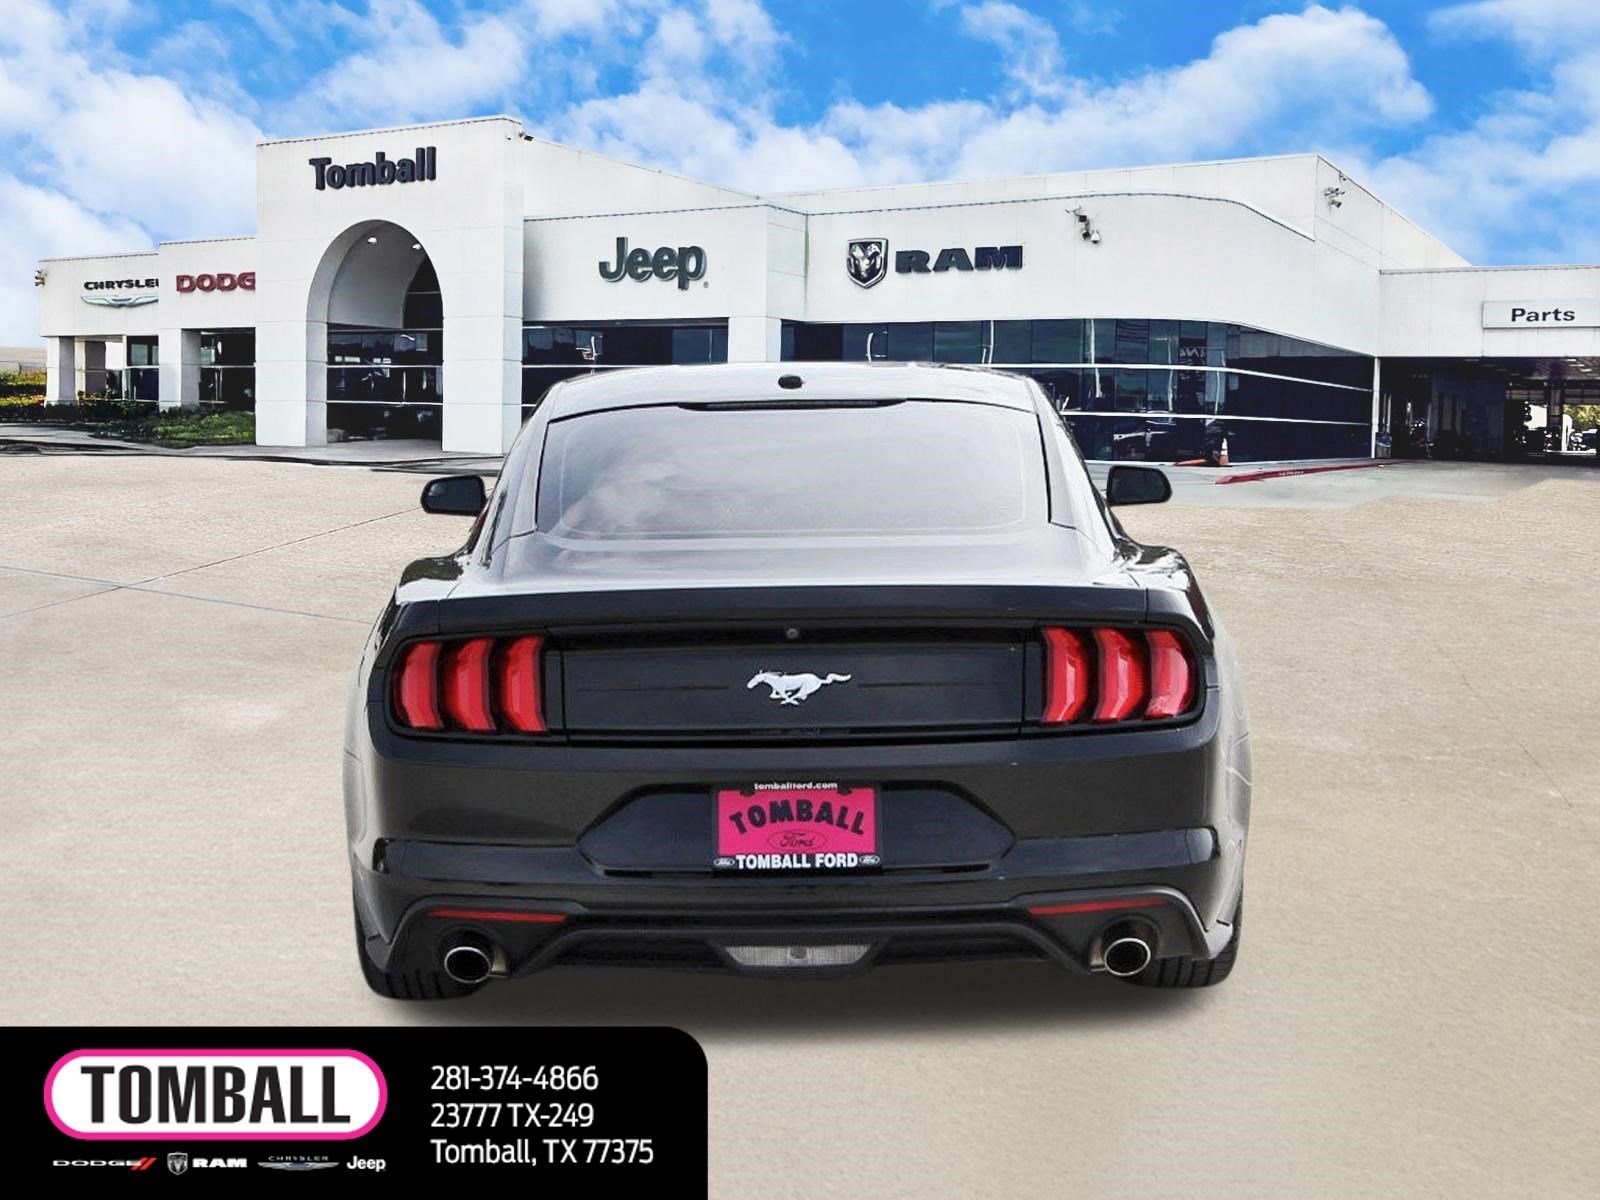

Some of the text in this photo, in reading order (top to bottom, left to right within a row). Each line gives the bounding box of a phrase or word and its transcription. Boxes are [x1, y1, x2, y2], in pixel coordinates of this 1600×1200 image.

[308, 146, 436, 191] Tomball
[598, 237, 707, 290] Jeep
[895, 245, 1023, 275] RAM
[84, 278, 159, 290] CHRYSLE
[1511, 307, 1575, 323] Parts
[729, 799, 864, 835] TOMBALL
[736, 854, 811, 869] TOMBALL
[815, 853, 858, 868] FORD
